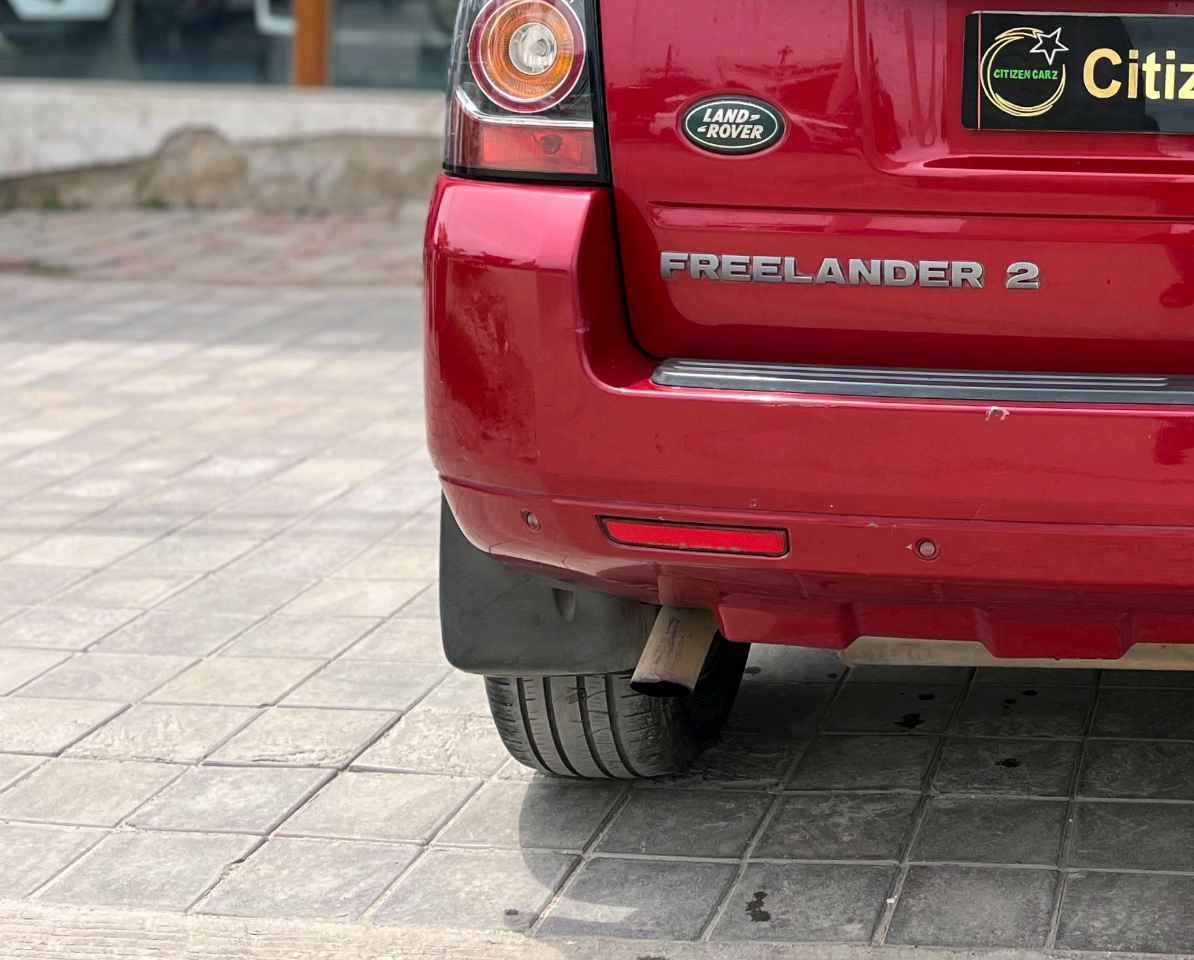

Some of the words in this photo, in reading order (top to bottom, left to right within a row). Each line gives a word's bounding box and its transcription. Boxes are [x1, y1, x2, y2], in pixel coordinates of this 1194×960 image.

[993, 68, 1031, 80] CITIZEN
[1032, 69, 1058, 80] CARZ
[703, 108, 750, 123] LAND
[706, 123, 764, 139] ROVER
[659, 251, 984, 289] FREELANDER
[1005, 261, 1041, 289] 2
